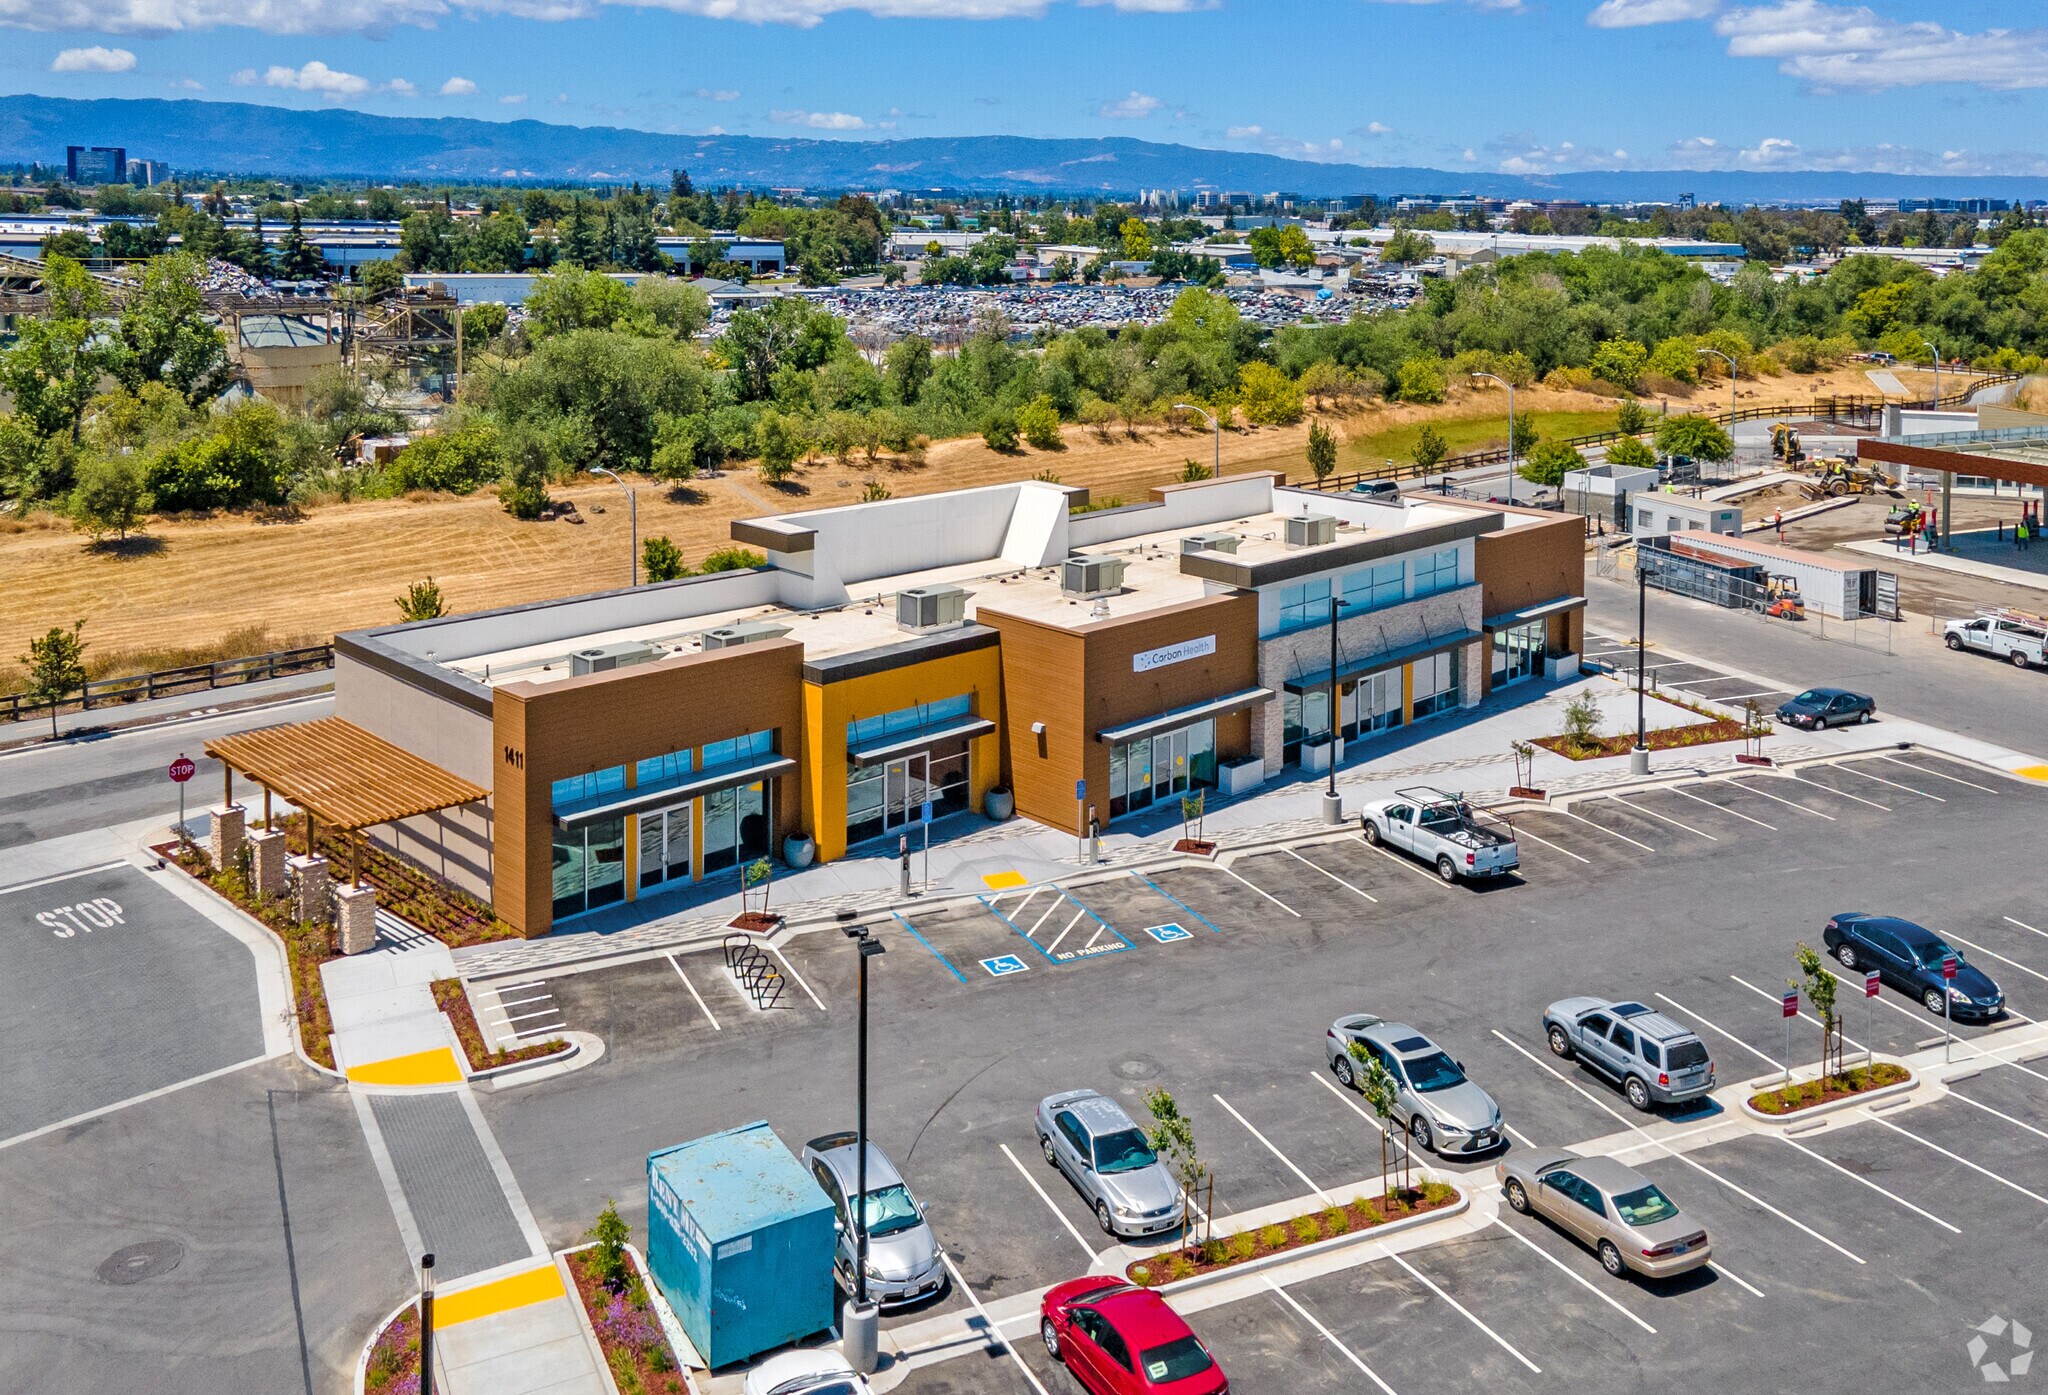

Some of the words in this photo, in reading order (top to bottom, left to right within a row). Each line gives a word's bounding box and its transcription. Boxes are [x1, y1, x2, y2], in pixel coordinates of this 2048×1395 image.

[1152, 650, 1182, 664] Carbon
[1183, 641, 1209, 656] Health
[504, 745, 523, 770] 1411
[170, 764, 194, 776] STOP
[36, 898, 126, 938] STOP
[1056, 951, 1075, 960] NO
[1076, 942, 1126, 956] PARKING
